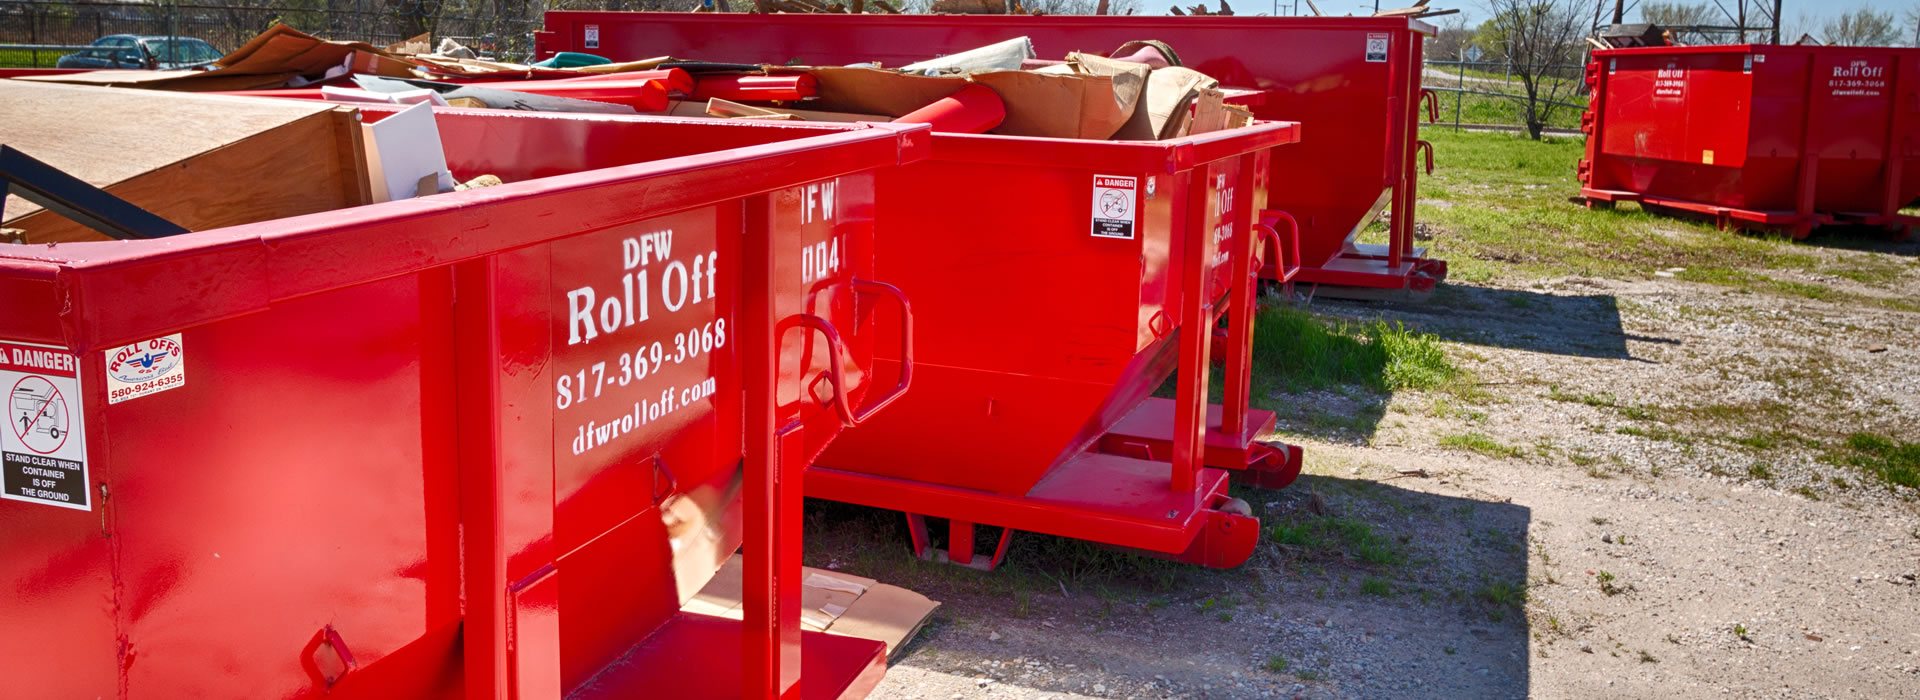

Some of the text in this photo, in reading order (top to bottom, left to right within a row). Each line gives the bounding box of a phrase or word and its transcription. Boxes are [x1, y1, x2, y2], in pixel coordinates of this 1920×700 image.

[1833, 66, 1883, 77] Roll Off
[1104, 178, 1134, 187] DANGER
[1221, 187, 1234, 214] Off
[622, 229, 673, 270] DFW
[802, 236, 839, 285] 004
[567, 250, 718, 345] Roll Off
[12, 347, 74, 372] DANGER
[110, 339, 180, 373] ROLL OFFS
[556, 317, 726, 410] 817-369-3068
[111, 373, 183, 399] 580-924-6355
[572, 376, 717, 456] dfwrolloff.com
[5, 453, 81, 471] STAND CLEAR WHEN
[22, 466, 65, 479] CONTAINER
[21, 487, 70, 501] THE GROUND
[32, 478, 57, 489] IS OFF
